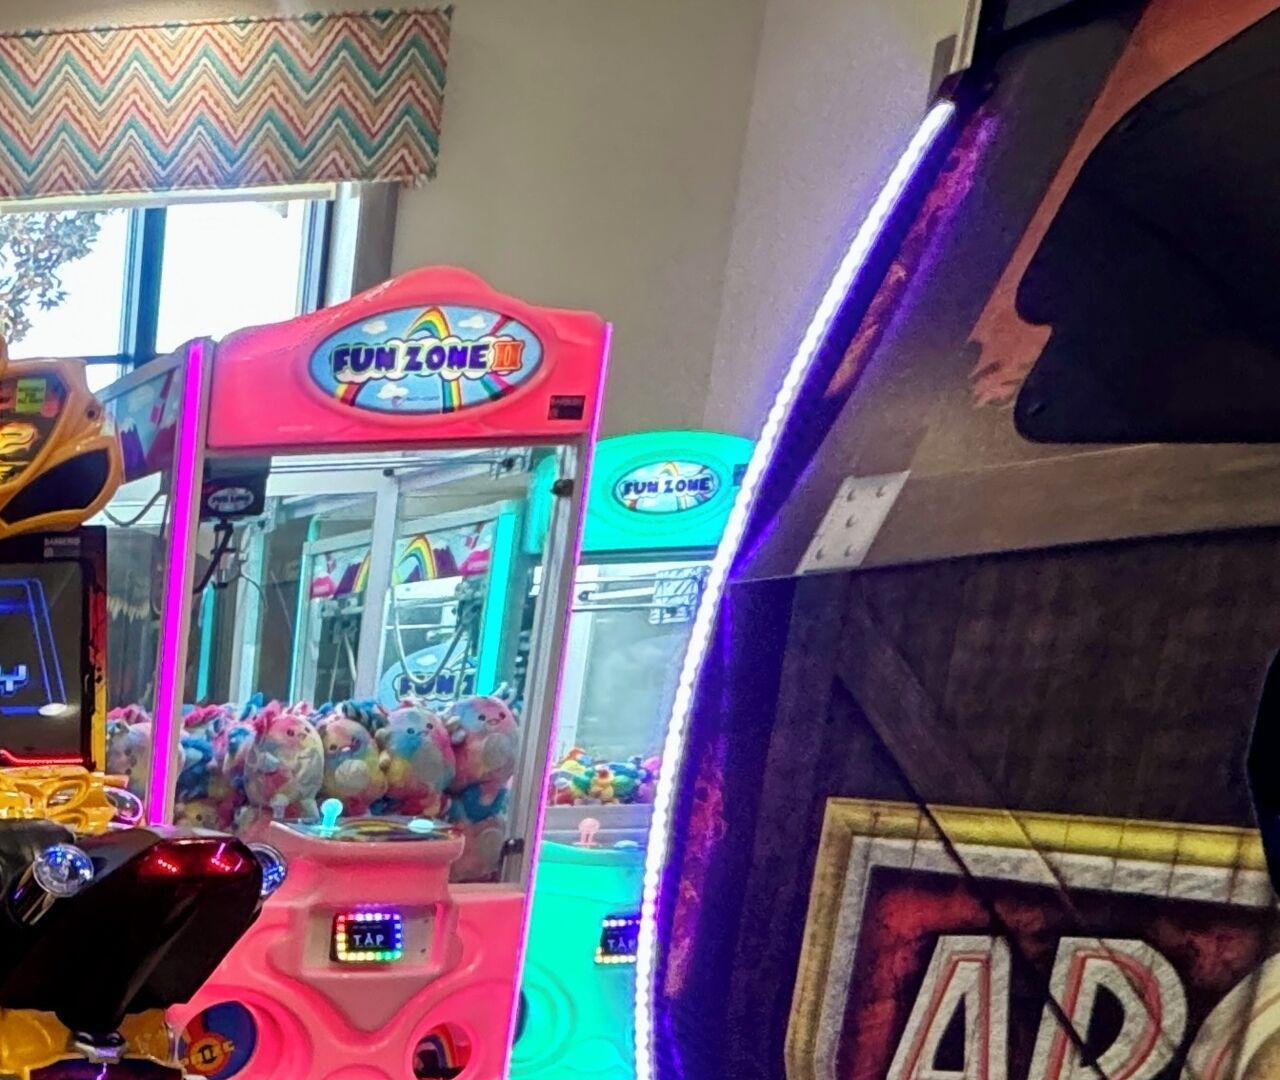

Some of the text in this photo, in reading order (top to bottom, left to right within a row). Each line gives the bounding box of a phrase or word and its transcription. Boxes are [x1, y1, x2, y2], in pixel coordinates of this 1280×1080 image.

[333, 343, 396, 372] FUN
[404, 344, 490, 371] ZONE
[623, 477, 711, 495] FUN ZONE
[352, 932, 385, 947] TAP
